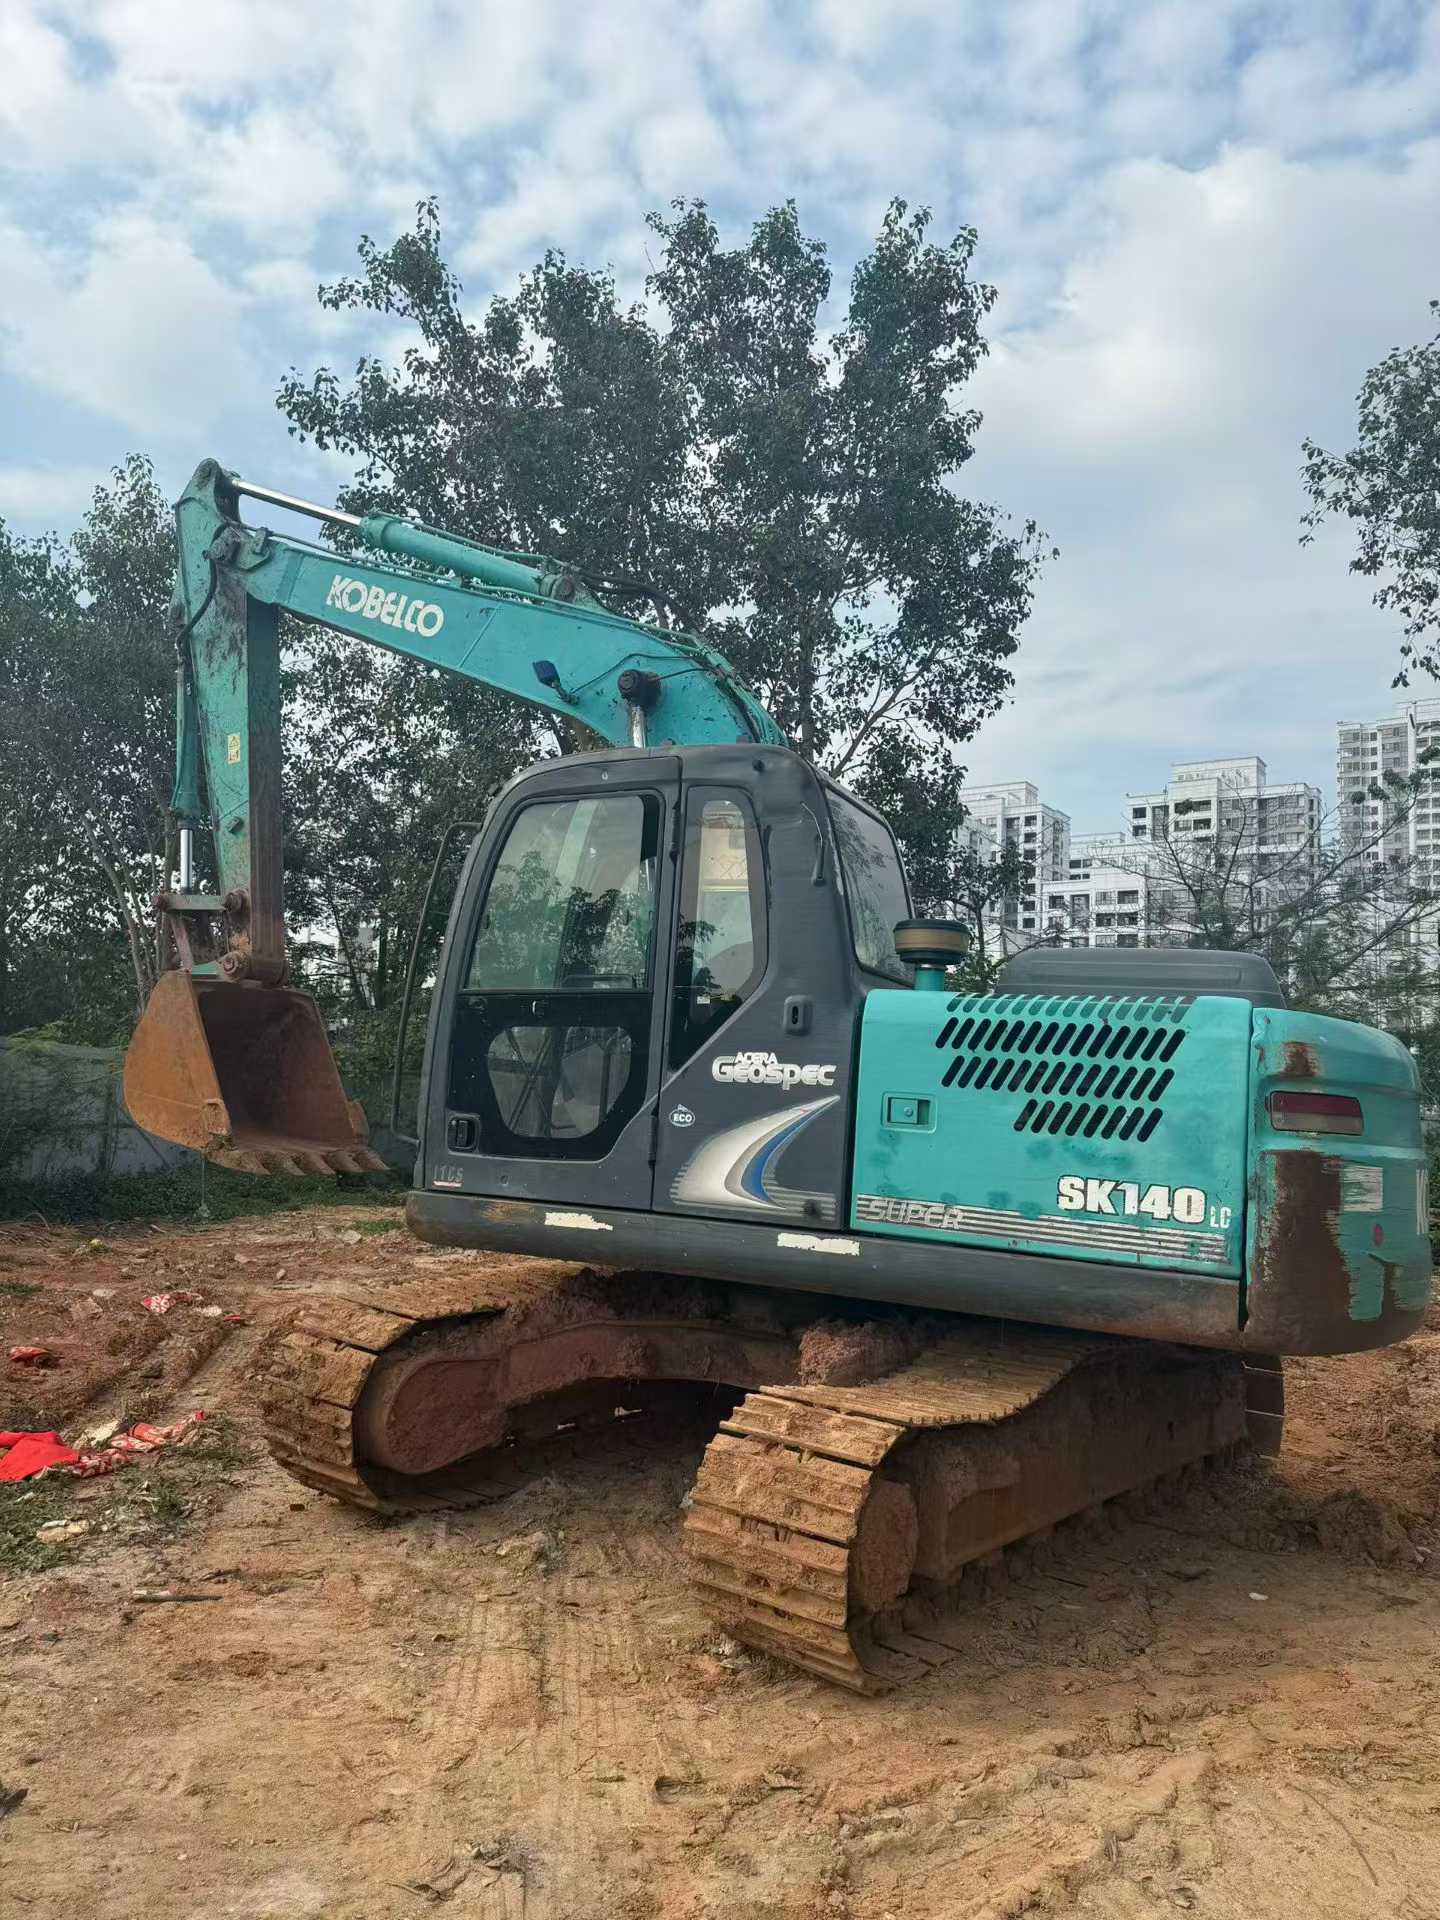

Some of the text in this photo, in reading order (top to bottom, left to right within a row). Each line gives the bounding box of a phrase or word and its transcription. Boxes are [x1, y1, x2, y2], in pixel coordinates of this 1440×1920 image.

[326, 575, 445, 637] KOBELCO
[735, 1052, 778, 1065] ACERA
[673, 1113, 692, 1122] ECO
[865, 1199, 962, 1229] SUPER
[1057, 1175, 1232, 1229] SK140 LC
